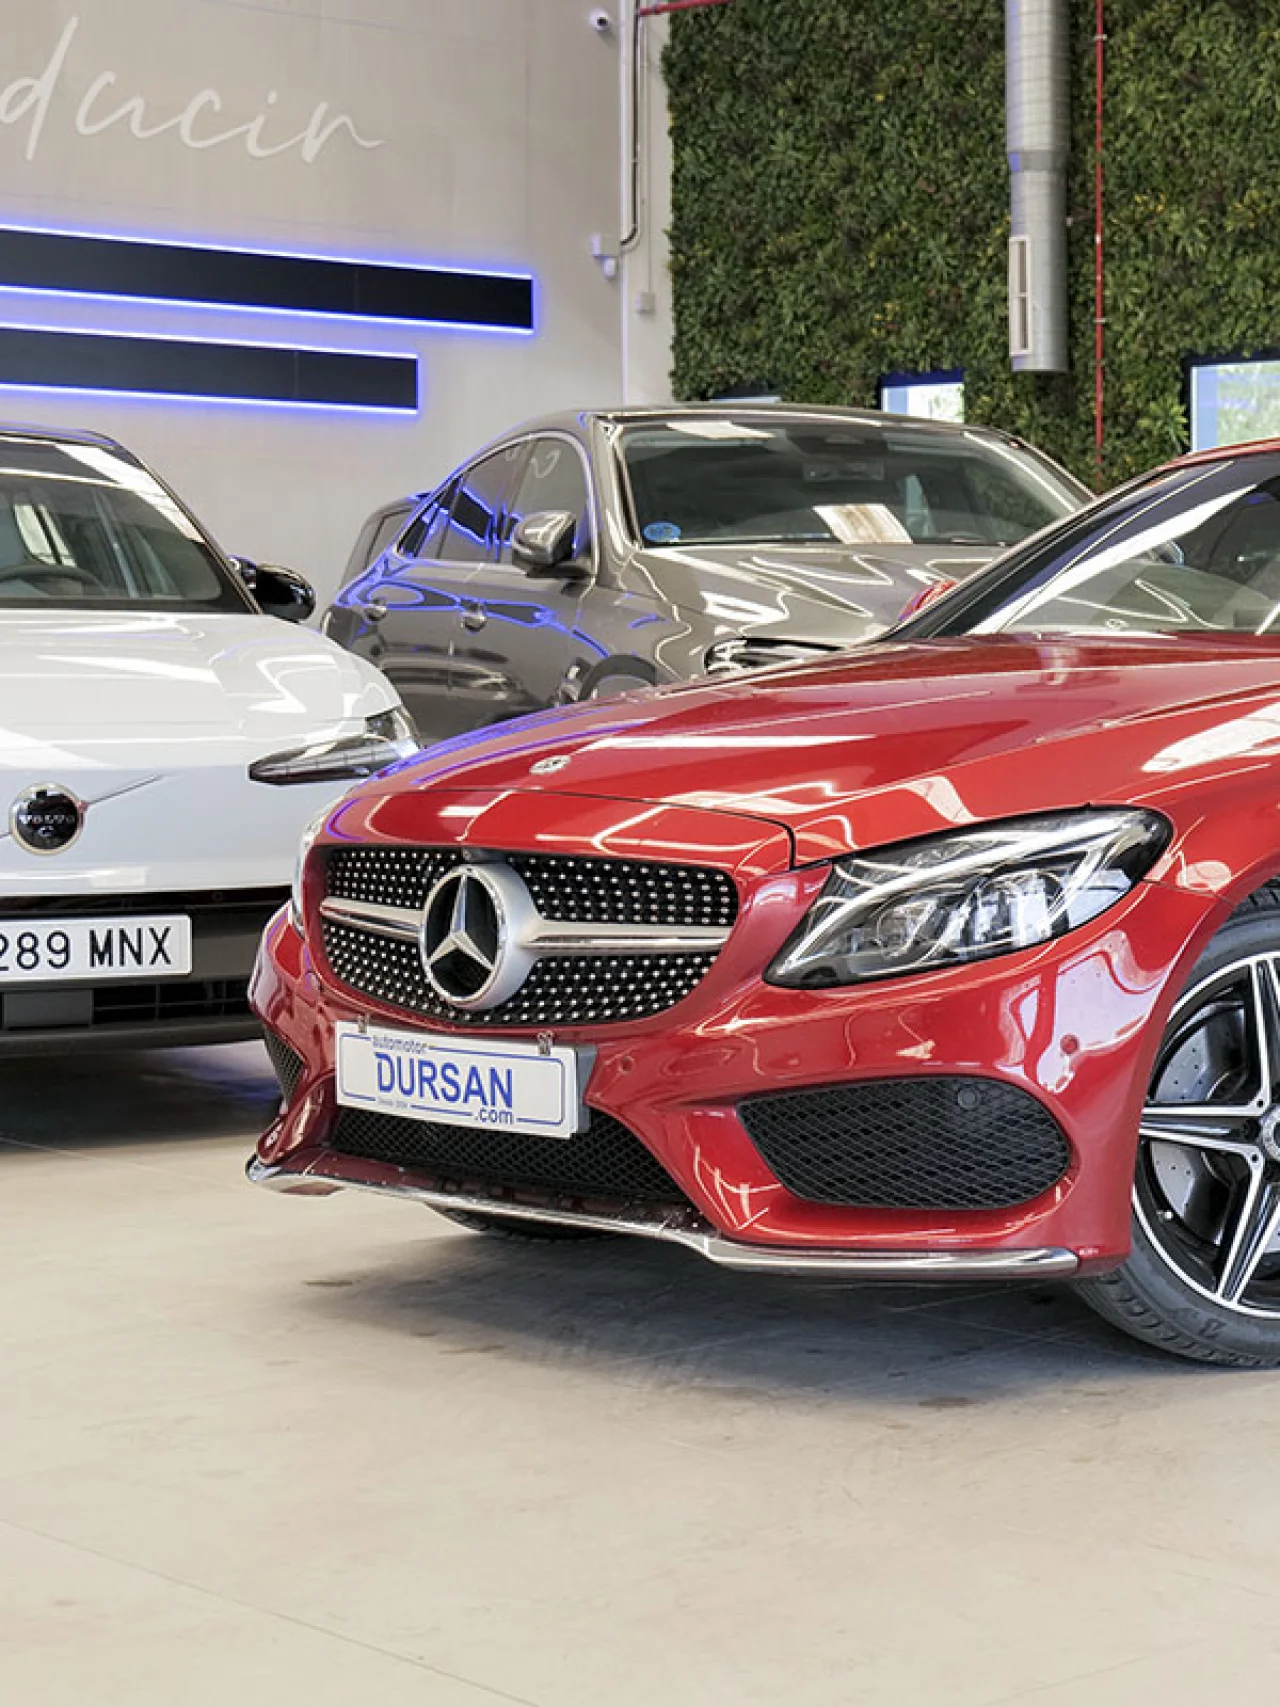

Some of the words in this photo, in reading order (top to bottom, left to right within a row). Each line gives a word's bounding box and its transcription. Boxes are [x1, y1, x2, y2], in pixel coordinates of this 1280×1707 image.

[89, 926, 172, 968] MNX
[374, 1052, 513, 1109] DURSAN
[474, 1108, 514, 1125] .com
